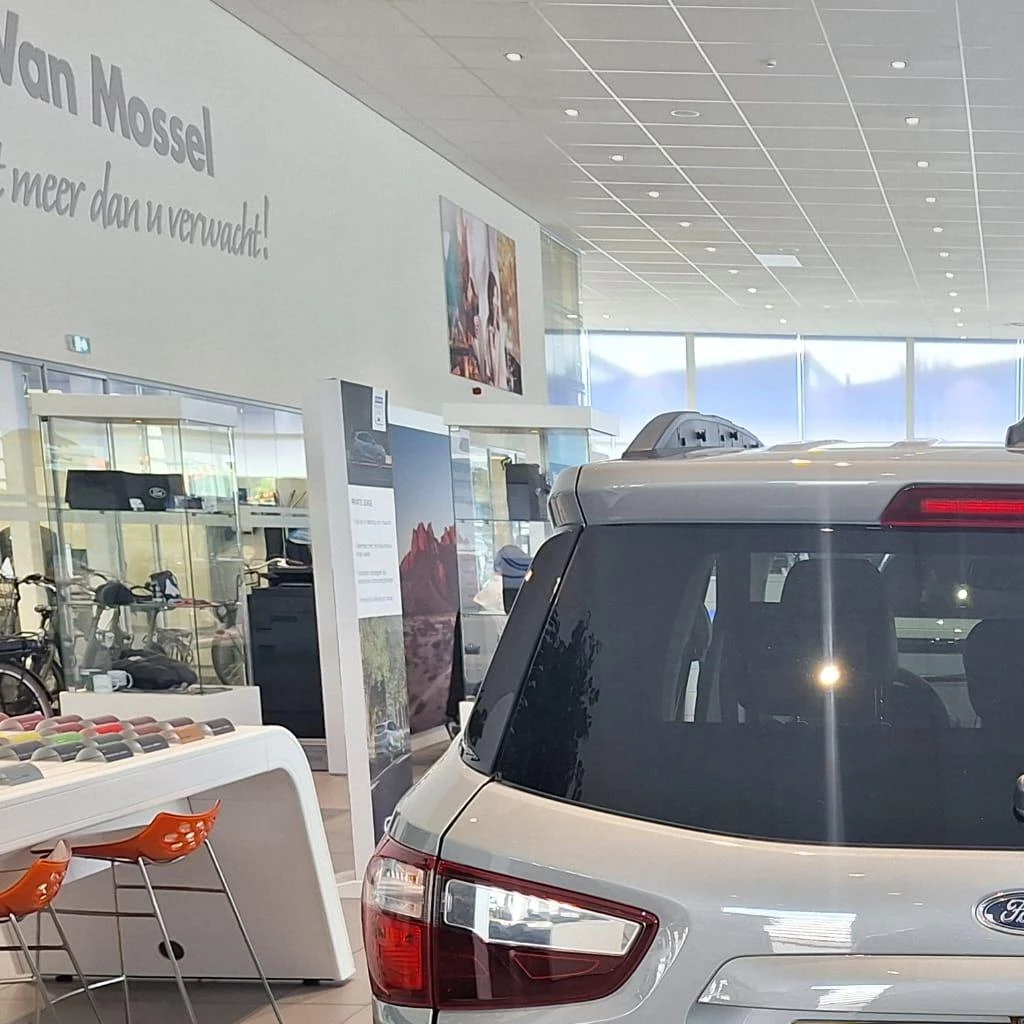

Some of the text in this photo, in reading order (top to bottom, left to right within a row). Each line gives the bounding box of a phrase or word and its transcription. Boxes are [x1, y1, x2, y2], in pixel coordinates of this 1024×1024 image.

[91, 53, 215, 178] Mossel
[11, 167, 86, 218] meer
[90, 161, 140, 232] dan
[146, 200, 163, 236] u
[168, 195, 270, 260] verwacht!
